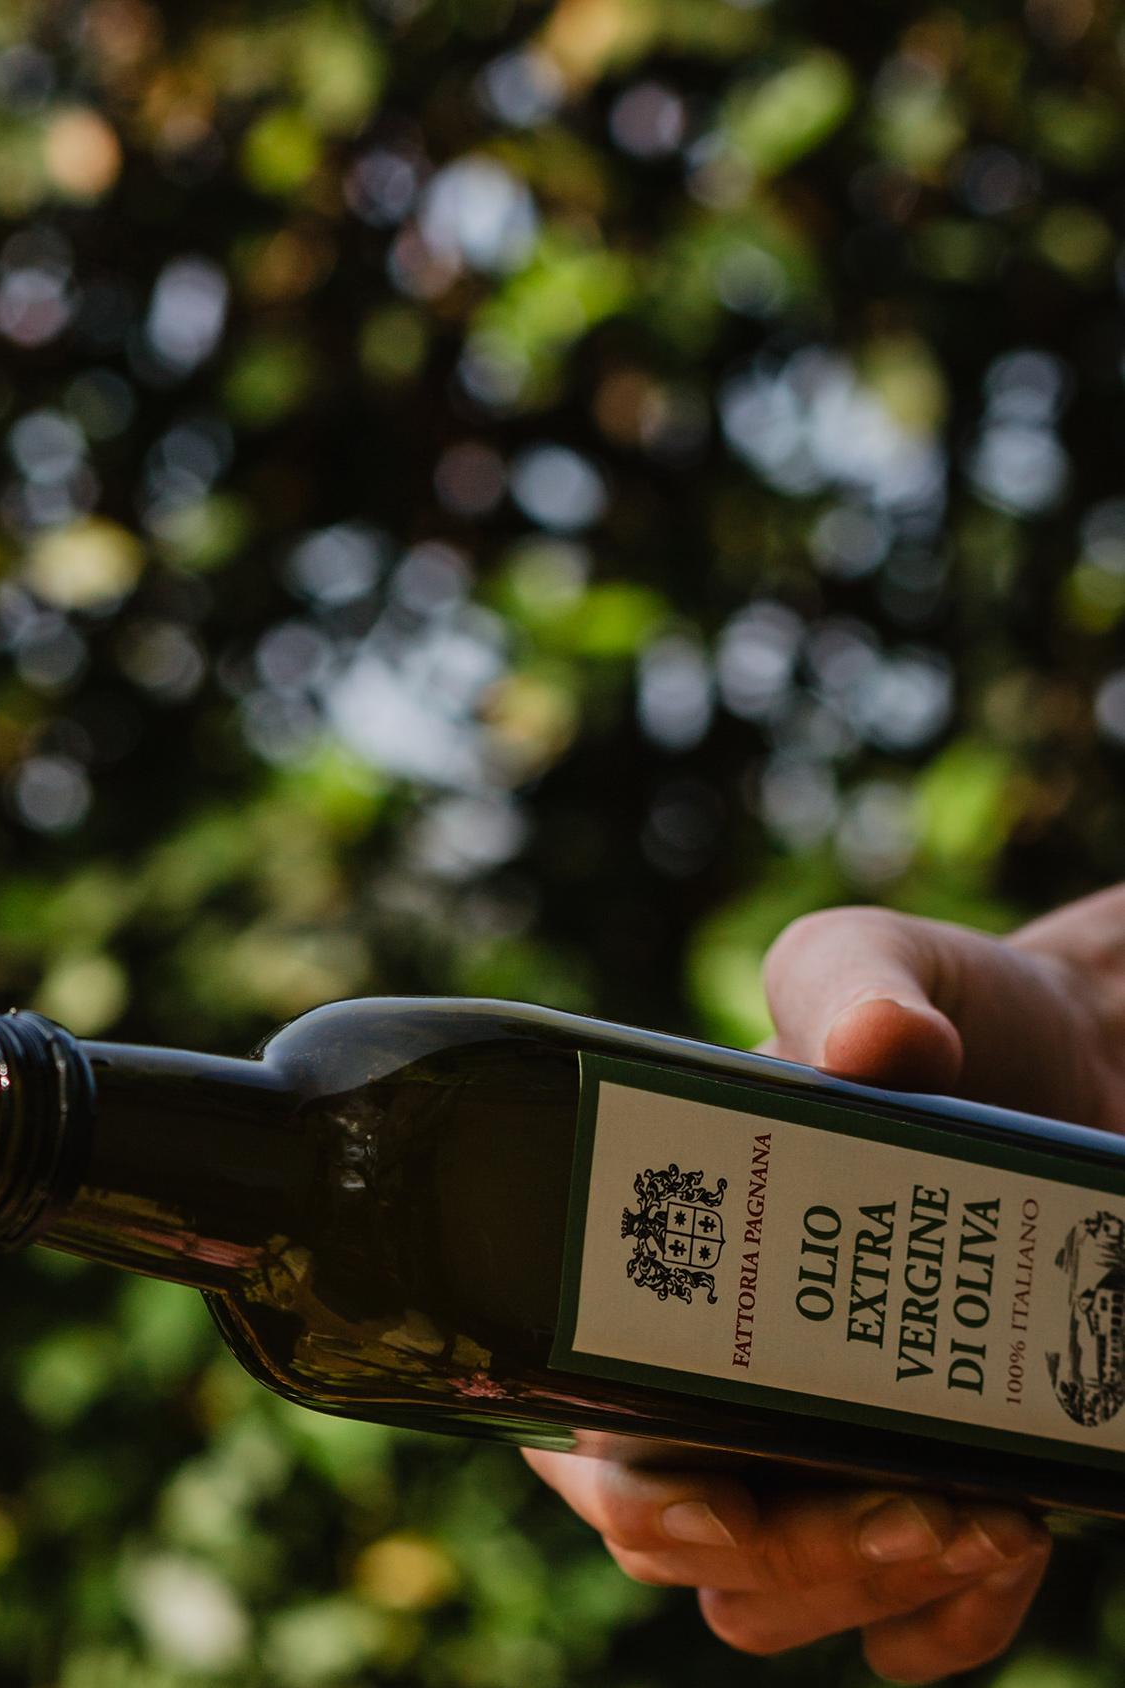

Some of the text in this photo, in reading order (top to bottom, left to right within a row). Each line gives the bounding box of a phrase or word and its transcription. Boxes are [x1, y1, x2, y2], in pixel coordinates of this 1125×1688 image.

[732, 1133, 772, 1369] FATTORIA PAGNANA
[796, 1205, 842, 1322] OLIO
[846, 1201, 896, 1349] EXTRA
[896, 1184, 951, 1382] VERGINE
[948, 1198, 1001, 1395] DI OLIVA
[1006, 1198, 1040, 1405] 100% ITALIANO
